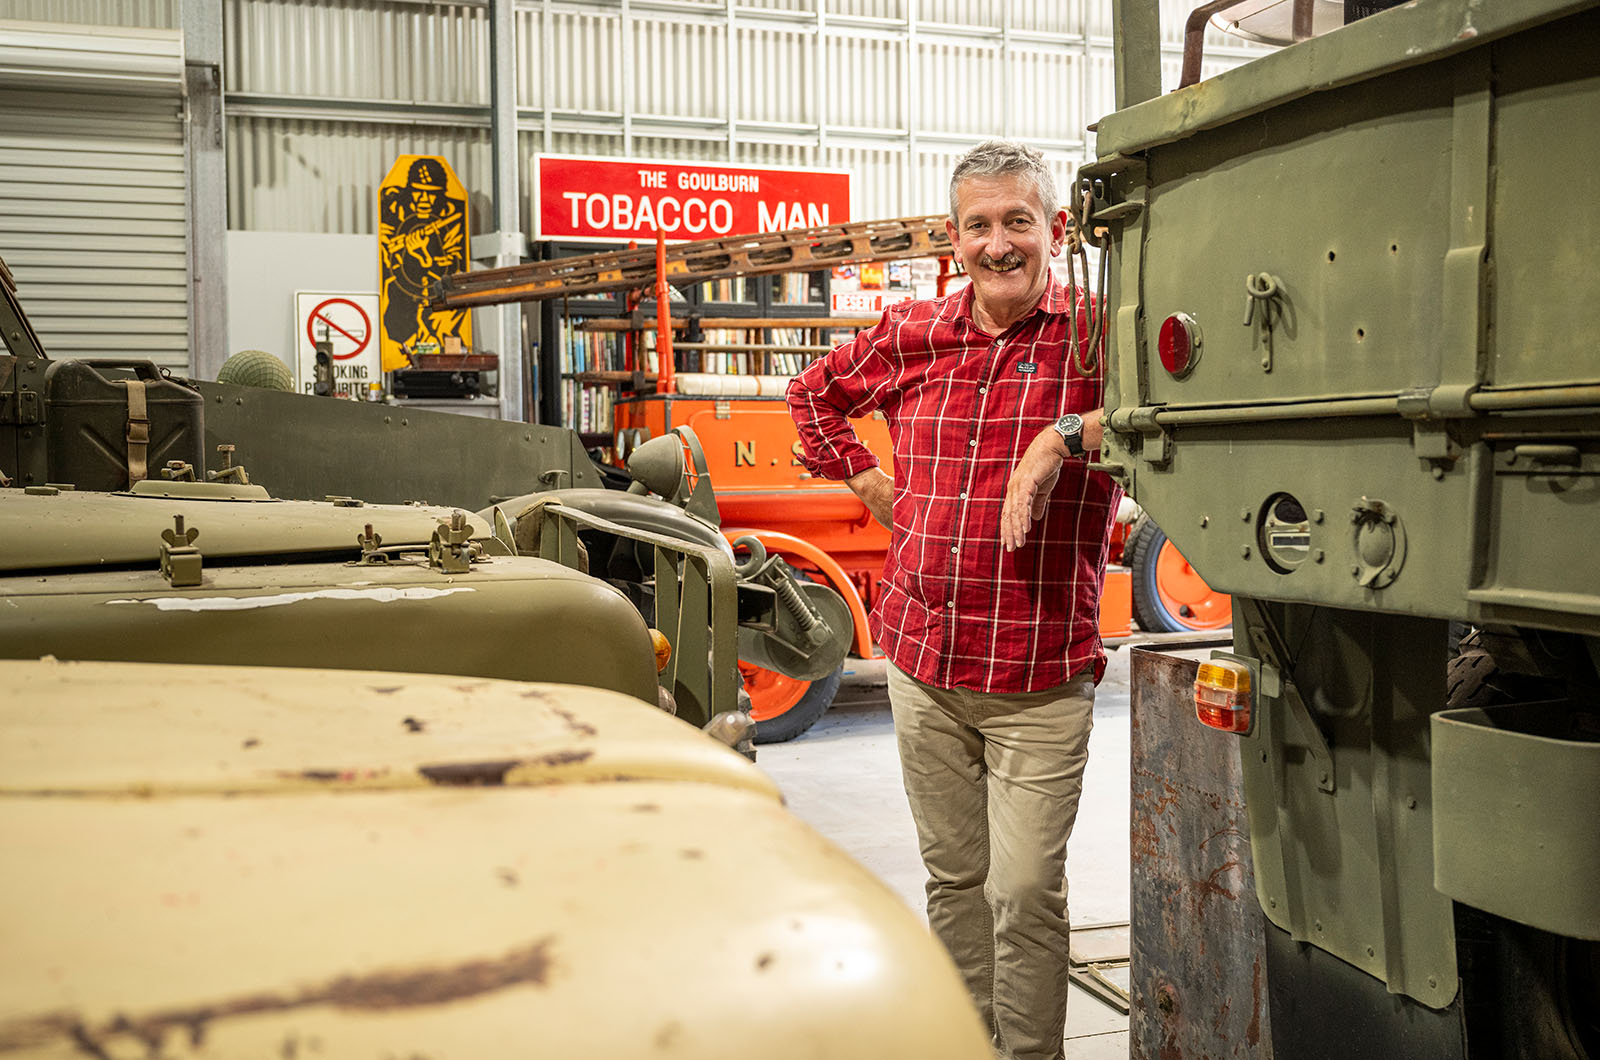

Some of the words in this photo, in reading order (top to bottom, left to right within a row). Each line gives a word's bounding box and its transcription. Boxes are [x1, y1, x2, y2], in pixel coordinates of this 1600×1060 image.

[638, 170, 667, 189] THE
[678, 172, 759, 193] GOULBURN
[562, 192, 733, 233] TOBACCO
[757, 200, 829, 234] MAN
[313, 365, 368, 379] SOKING
